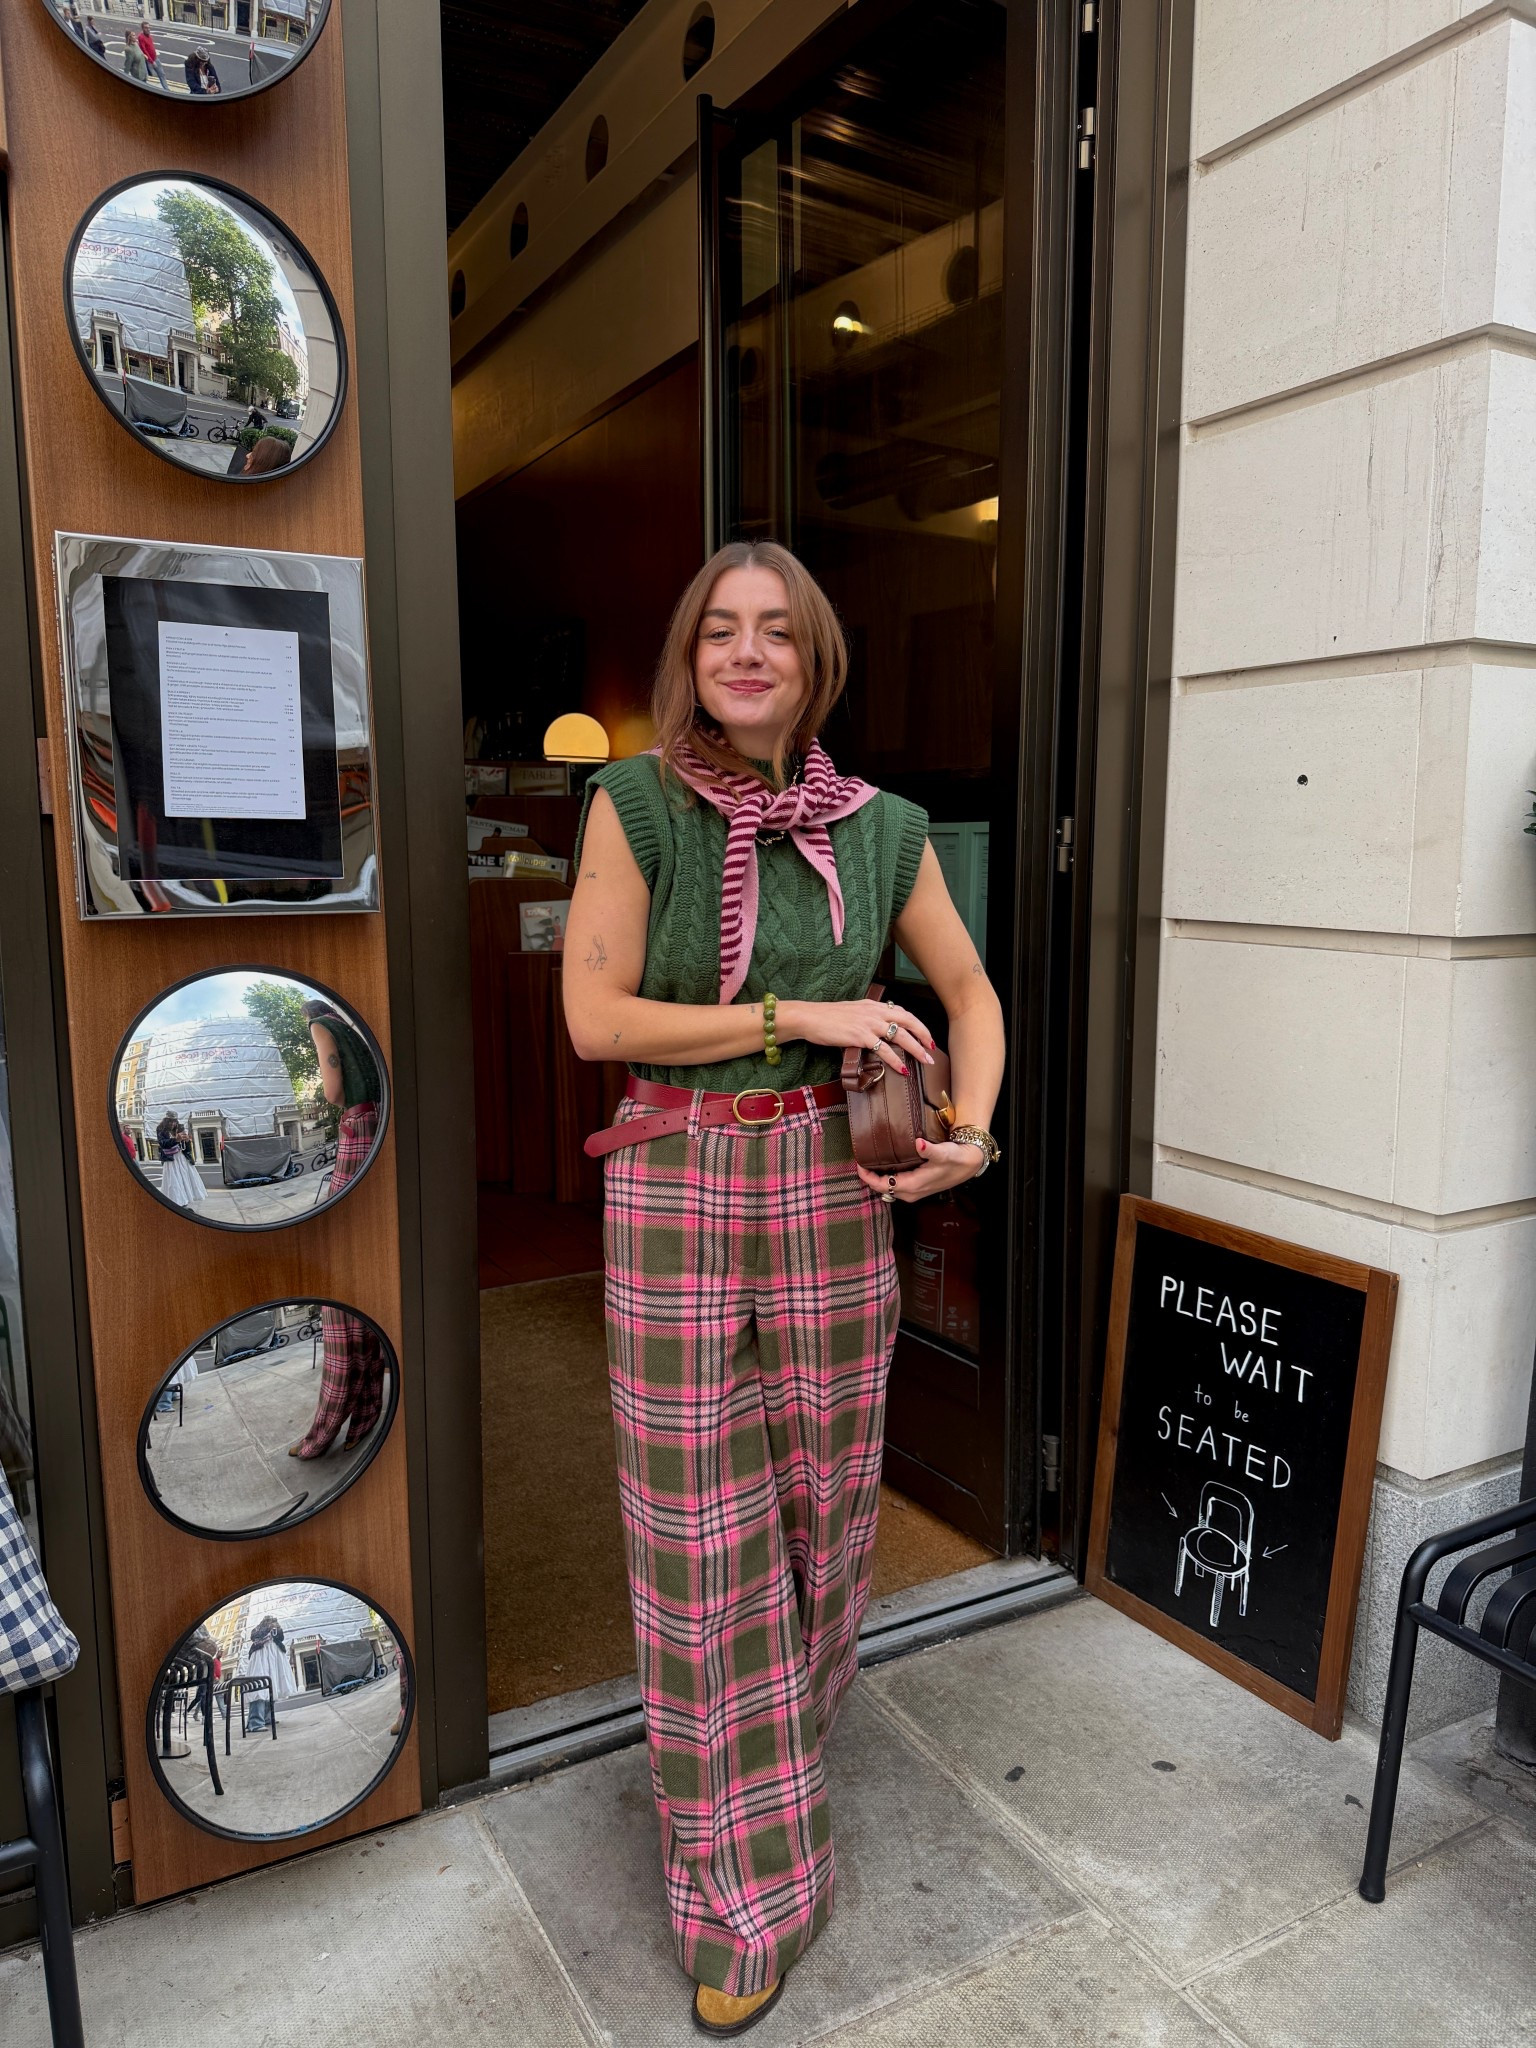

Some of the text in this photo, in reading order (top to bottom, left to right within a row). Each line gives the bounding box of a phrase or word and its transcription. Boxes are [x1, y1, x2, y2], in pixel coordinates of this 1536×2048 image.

[520, 769, 556, 780] TABLE
[469, 855, 496, 866] THE
[1160, 1275, 1282, 1346] PLEASE
[1220, 1342, 1314, 1403] WAIT
[1194, 1383, 1250, 1423] to be
[1157, 1405, 1292, 1489] SEATED
